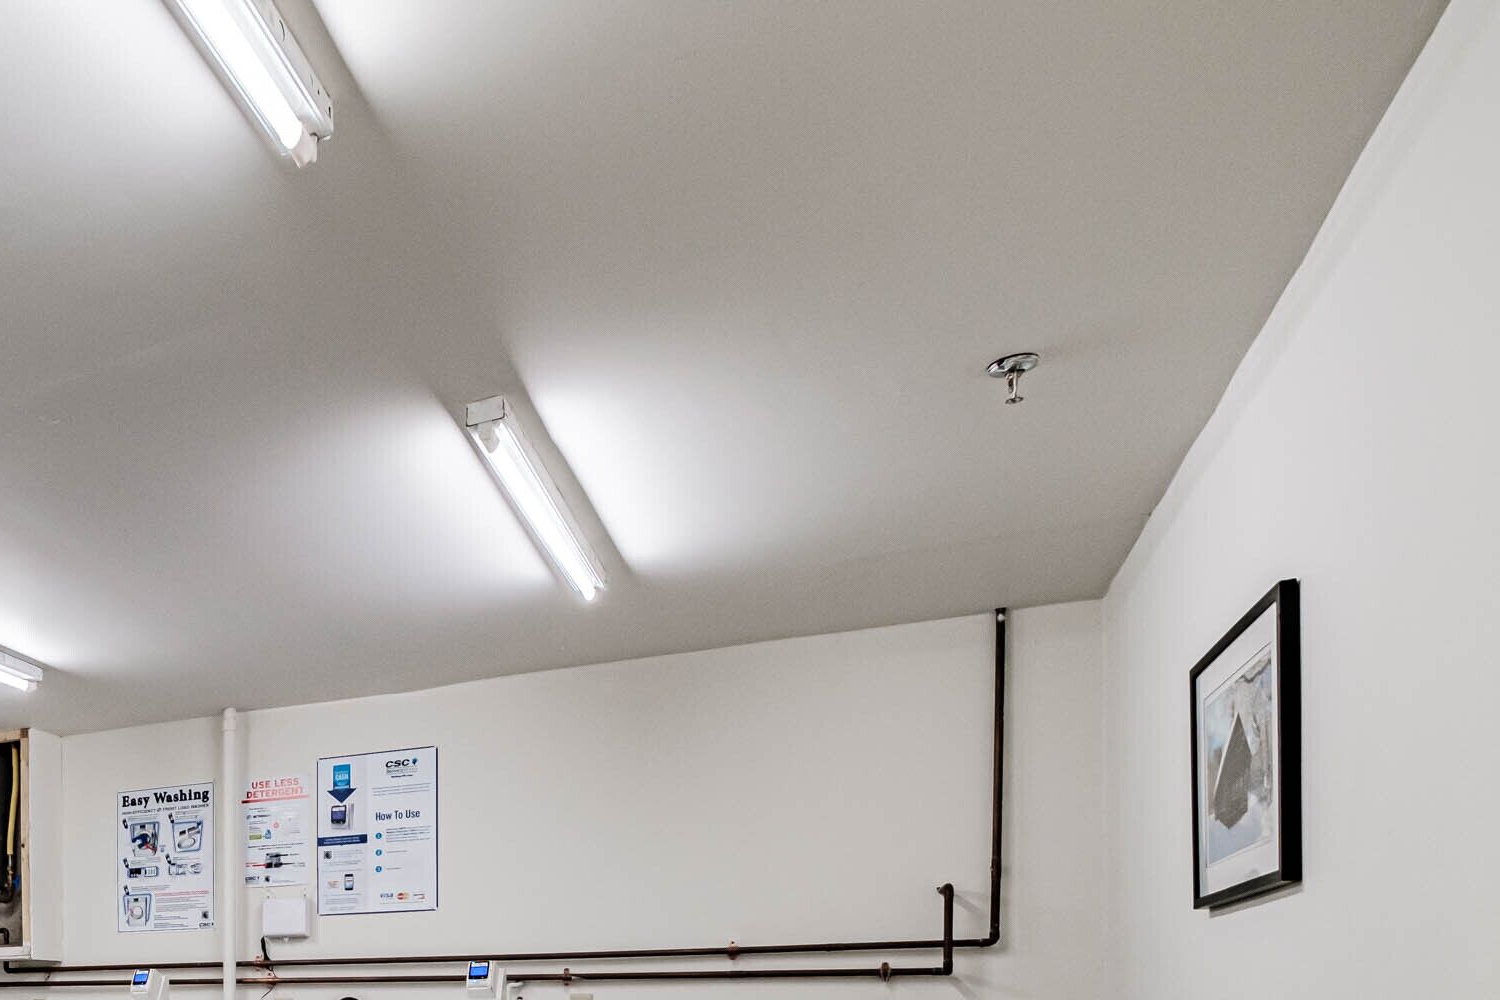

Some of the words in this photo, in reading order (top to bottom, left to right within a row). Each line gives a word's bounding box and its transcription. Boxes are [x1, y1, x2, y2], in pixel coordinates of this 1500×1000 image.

[385, 759, 410, 768] CSC
[251, 780, 271, 789] USE
[275, 777, 299, 787] LESS
[122, 795, 150, 808] Easy
[153, 789, 210, 803] Washing
[246, 787, 305, 799] DETERGENT
[375, 811, 393, 821] How
[395, 810, 404, 819] To
[405, 809, 421, 818] Use
